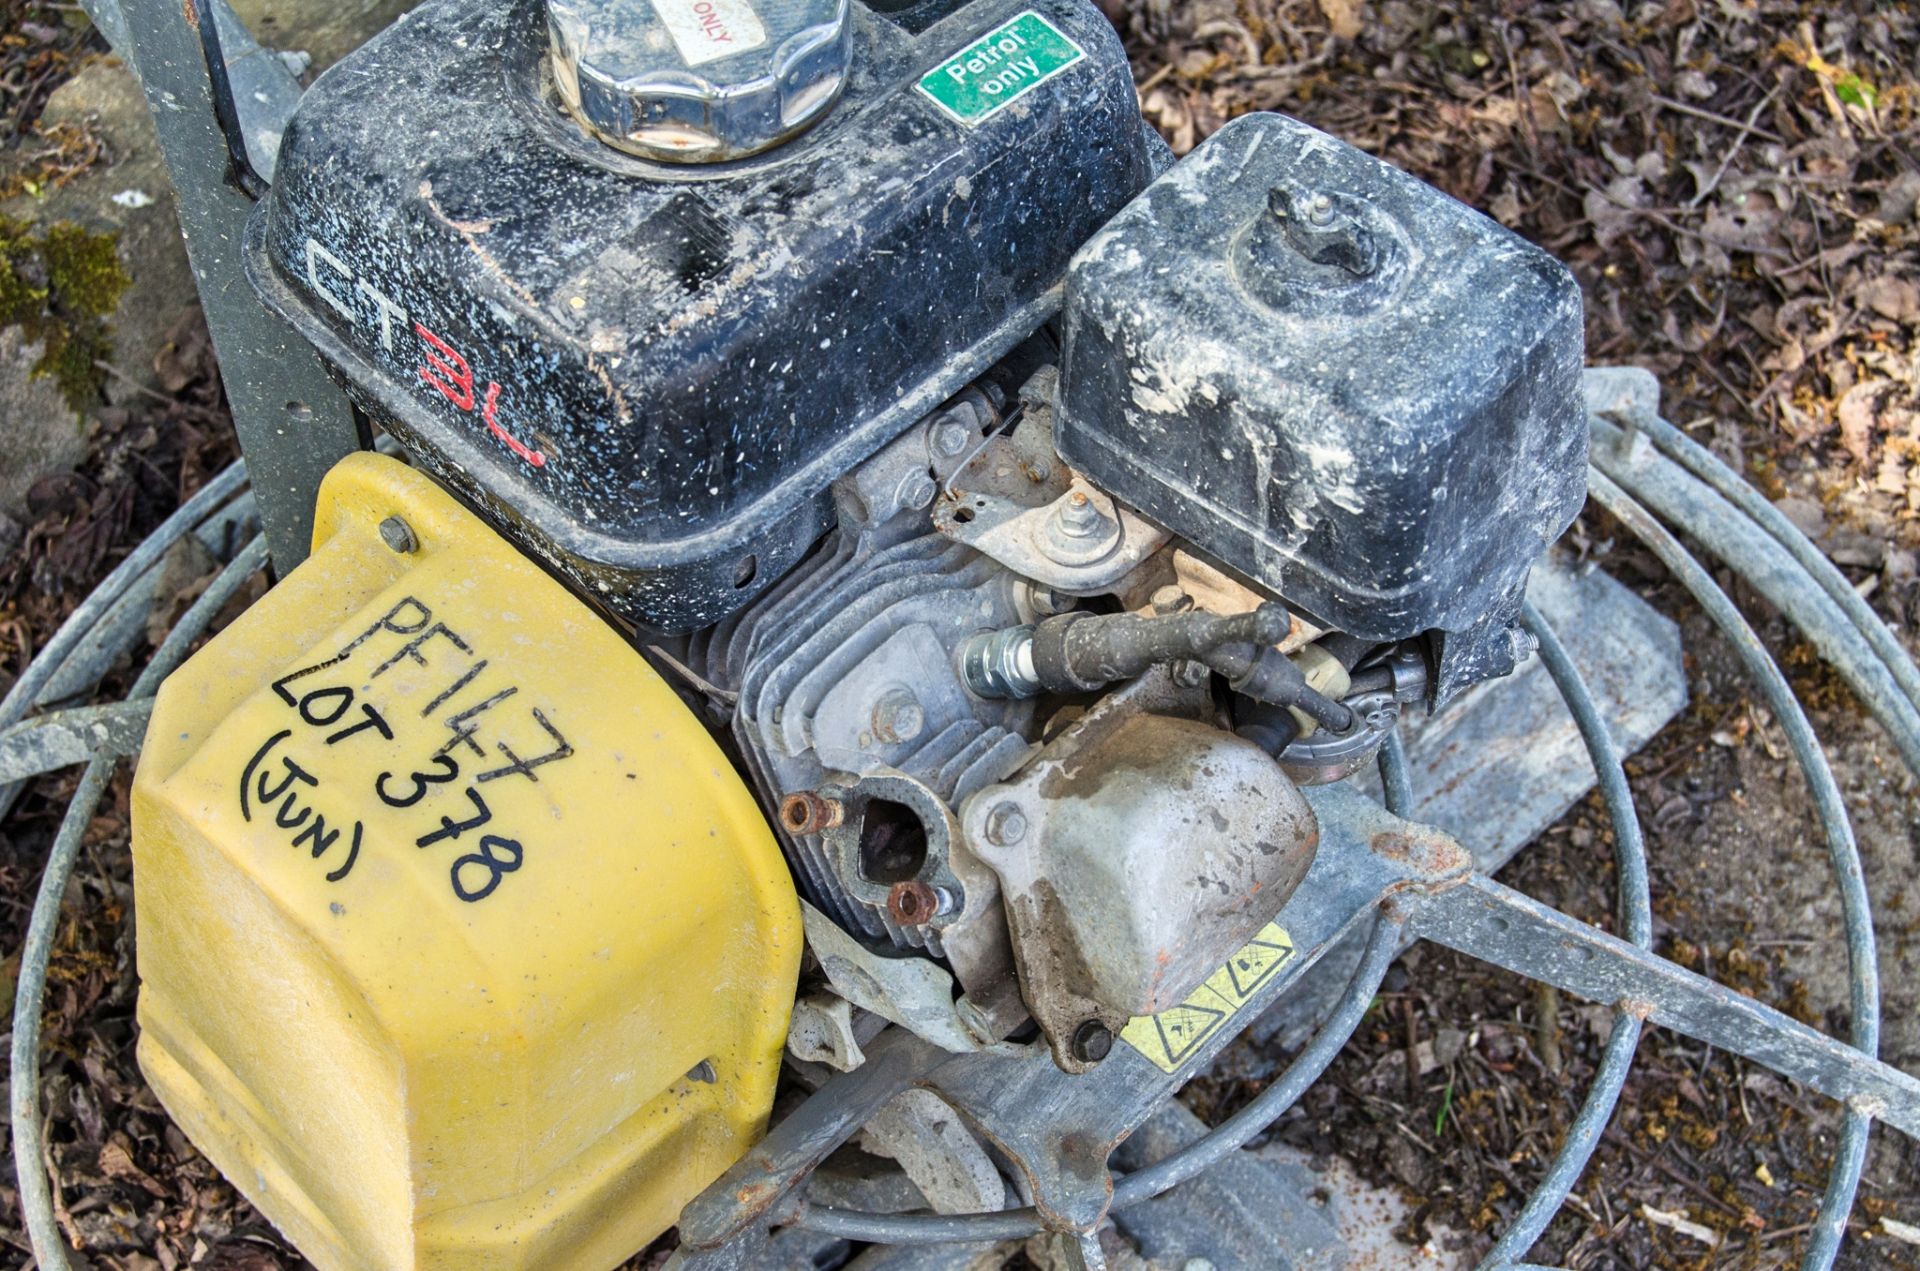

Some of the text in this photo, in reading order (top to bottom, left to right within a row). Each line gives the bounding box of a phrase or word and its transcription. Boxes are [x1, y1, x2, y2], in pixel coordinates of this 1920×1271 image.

[693, 2, 732, 43] ONLY
[946, 26, 1027, 85] Petrol
[984, 55, 1040, 95] only
[240, 729, 364, 882] (JUN)
[271, 653, 524, 903] LOT 378
